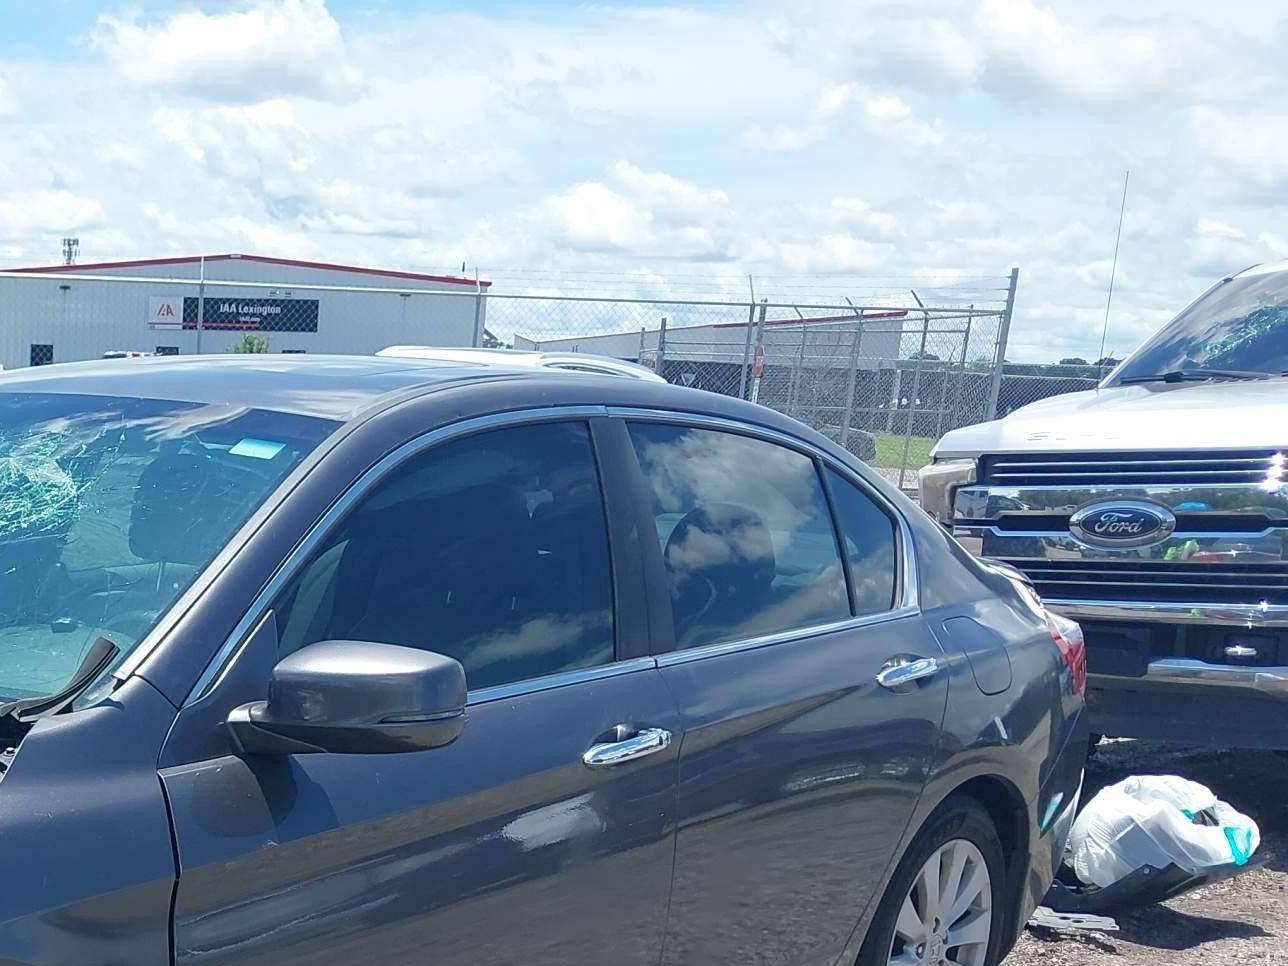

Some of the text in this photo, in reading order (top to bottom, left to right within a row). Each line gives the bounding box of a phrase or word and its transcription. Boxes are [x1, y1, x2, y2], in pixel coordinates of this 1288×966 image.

[219, 303, 281, 316] IAA Lexington
[1094, 512, 1144, 533] Ford
